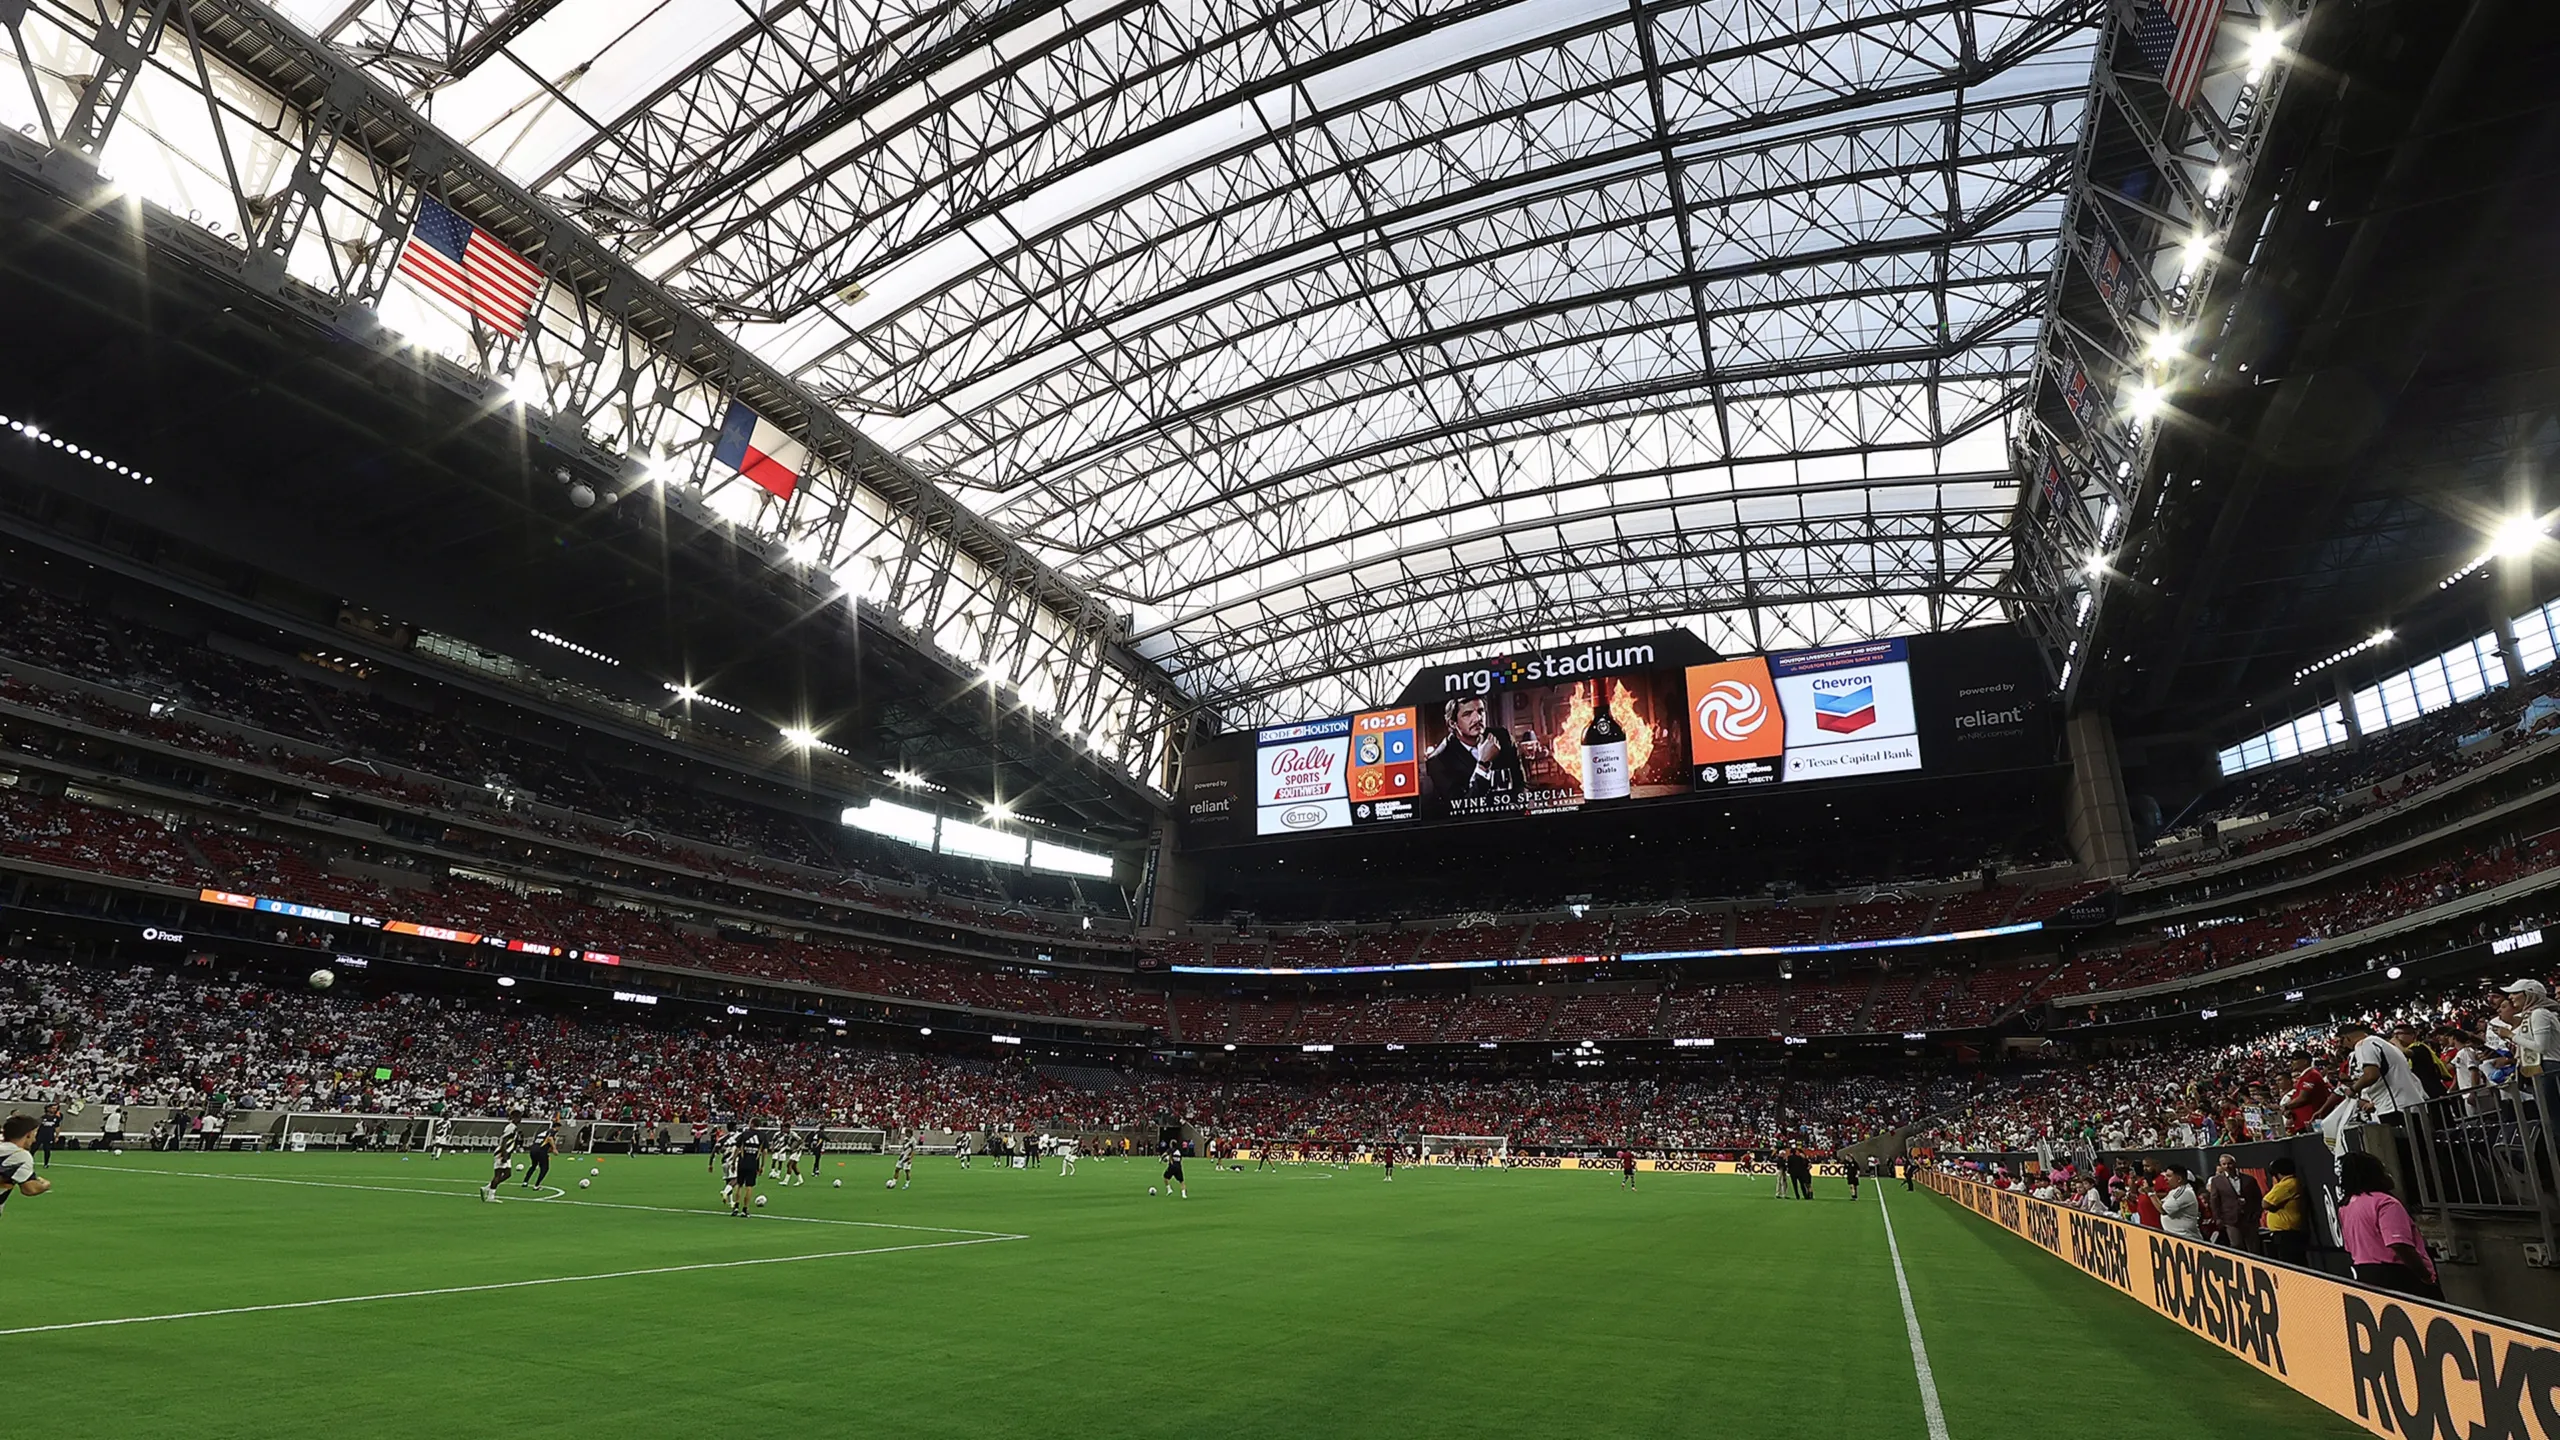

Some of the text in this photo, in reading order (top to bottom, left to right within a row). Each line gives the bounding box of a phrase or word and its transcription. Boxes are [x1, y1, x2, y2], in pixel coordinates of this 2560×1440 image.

[2115, 280, 2129, 310] 2015
[2081, 399, 2093, 423] 2012
[1444, 644, 1654, 694] nrg stadium
[1812, 674, 1872, 691] Chevron
[1959, 683, 2015, 698] powered by
[1360, 713, 1407, 730] 10:26
[1955, 707, 2023, 728] reliant
[1392, 742, 1404, 754] 0
[1271, 745, 1336, 776] Bally
[1806, 747, 1914, 768] Texas Capital Bank
[1194, 780, 1220, 790] powered
[1285, 772, 1320, 785] SPORTS
[1394, 773, 1406, 786] 0
[1278, 784, 1327, 799] SOUTHWEST
[1450, 788, 1575, 809] WINE SO SPECIAL
[1190, 799, 1230, 814] reliant
[270, 901, 335, 920] 0 RMA
[158, 931, 183, 943] Frost
[417, 925, 457, 941] 10:26
[522, 942, 578, 959] MUN 0
[2491, 929, 2543, 955] BOOT BARN
[613, 991, 657, 1005] BOOT BARN
[1655, 1160, 1716, 1172] ROCKSTAR
[2025, 1199, 2062, 1255] ROCKSTAR
[2069, 1211, 2132, 1292] ROCKSTAR
[2148, 1235, 2288, 1377] ROCKSTAR
